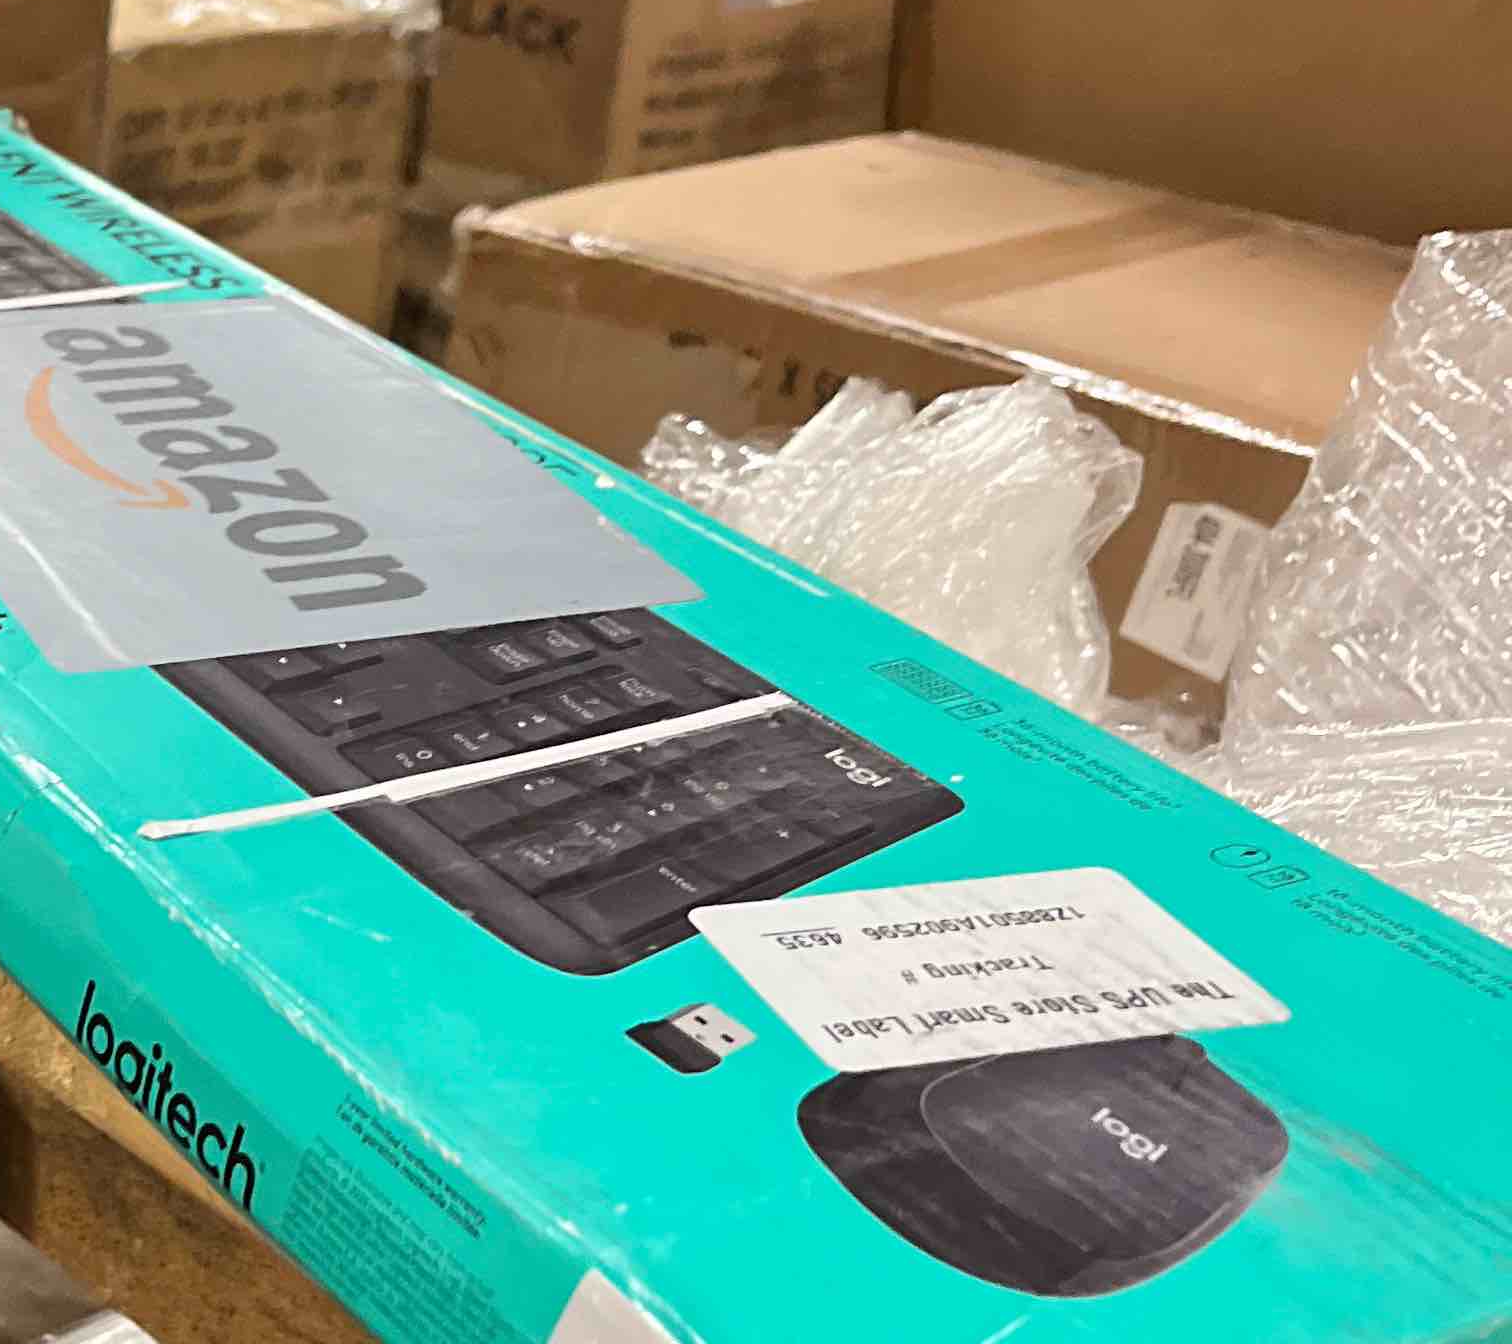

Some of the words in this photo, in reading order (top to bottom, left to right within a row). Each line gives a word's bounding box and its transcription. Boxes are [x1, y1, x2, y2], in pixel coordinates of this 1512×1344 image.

[51, 182, 245, 291] WIRELESS
[41, 325, 428, 613] amazon
[824, 749, 892, 788] logi
[777, 932, 843, 951] 4635
[900, 968, 920, 985] #
[929, 953, 1057, 981] Tracking
[1105, 985, 1174, 1010] UPS
[1175, 977, 1237, 1000] The
[921, 1001, 1011, 1030] Smart
[1014, 993, 1099, 1019] Store
[821, 1012, 914, 1044] Label
[75, 979, 258, 1214] logitech
[1090, 1107, 1169, 1163] logi
